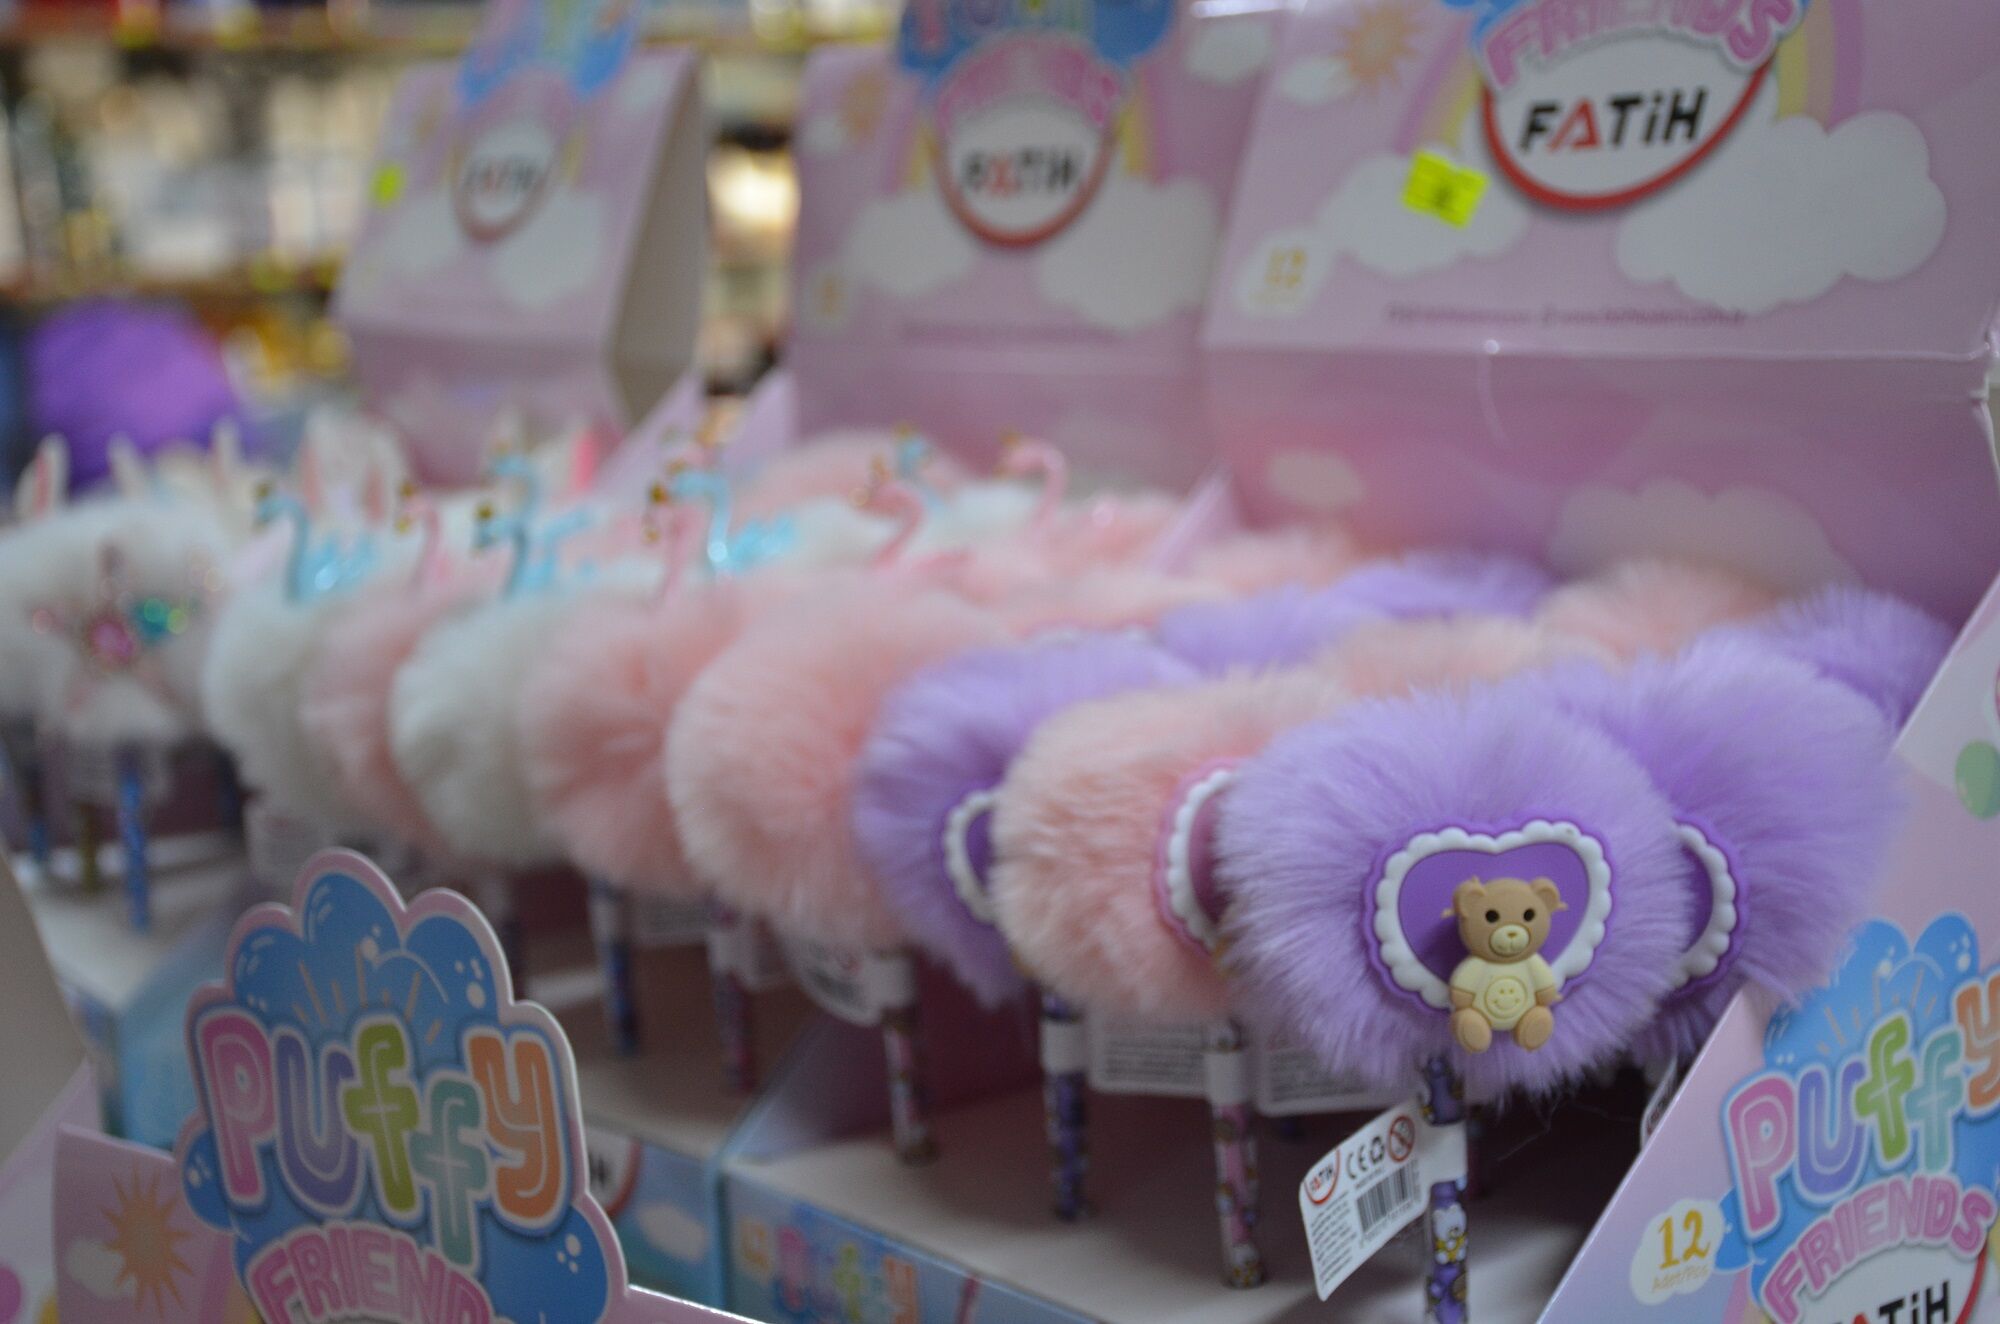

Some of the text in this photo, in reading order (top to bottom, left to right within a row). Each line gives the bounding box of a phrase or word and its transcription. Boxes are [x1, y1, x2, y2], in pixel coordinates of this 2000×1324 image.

[246, 1226, 492, 1324] FRIEND
[1658, 1208, 1711, 1270] 12
[1763, 1175, 1994, 1324] FRIENDS
